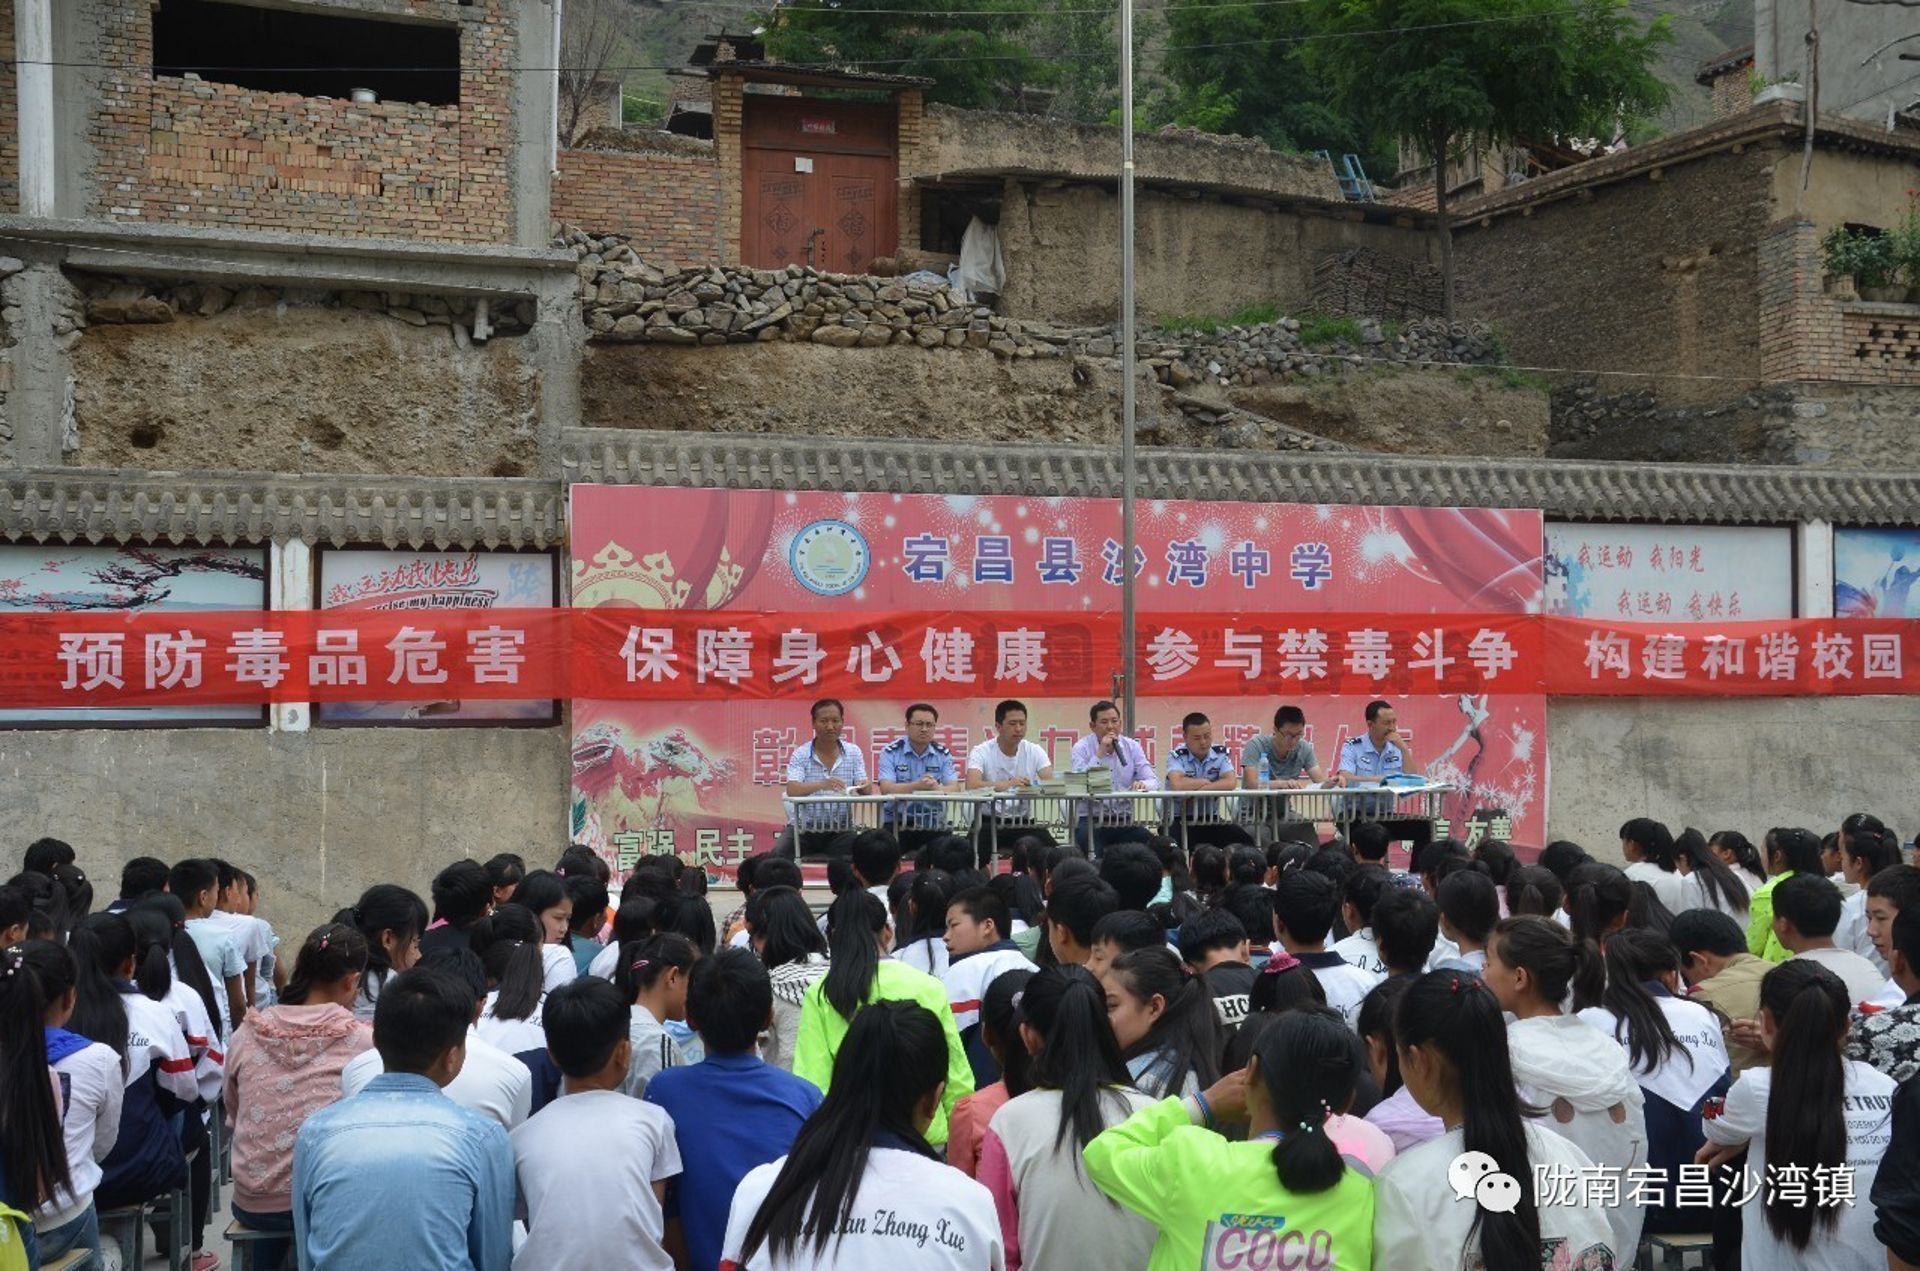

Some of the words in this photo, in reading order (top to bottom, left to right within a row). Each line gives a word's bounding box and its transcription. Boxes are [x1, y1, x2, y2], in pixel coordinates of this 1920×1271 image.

[902, 532, 1333, 589] 宕昌县沙湾中学
[1577, 542, 1633, 571] 我运动
[1650, 543, 1704, 573] 我阳光
[1617, 588, 1673, 617] 我运动
[1688, 589, 1741, 620] 我快乐
[57, 625, 526, 690] 预防毒品危害
[619, 626, 1048, 685] 保障身心健康
[1146, 627, 1518, 681] 参与禁毒斗争
[1584, 629, 1902, 681] 构建和谐校园
[695, 828, 755, 867] 民主
[872, 1208, 930, 1248] Zhong
[935, 1218, 965, 1252] Xue
[1216, 1227, 1332, 1271] COCO
